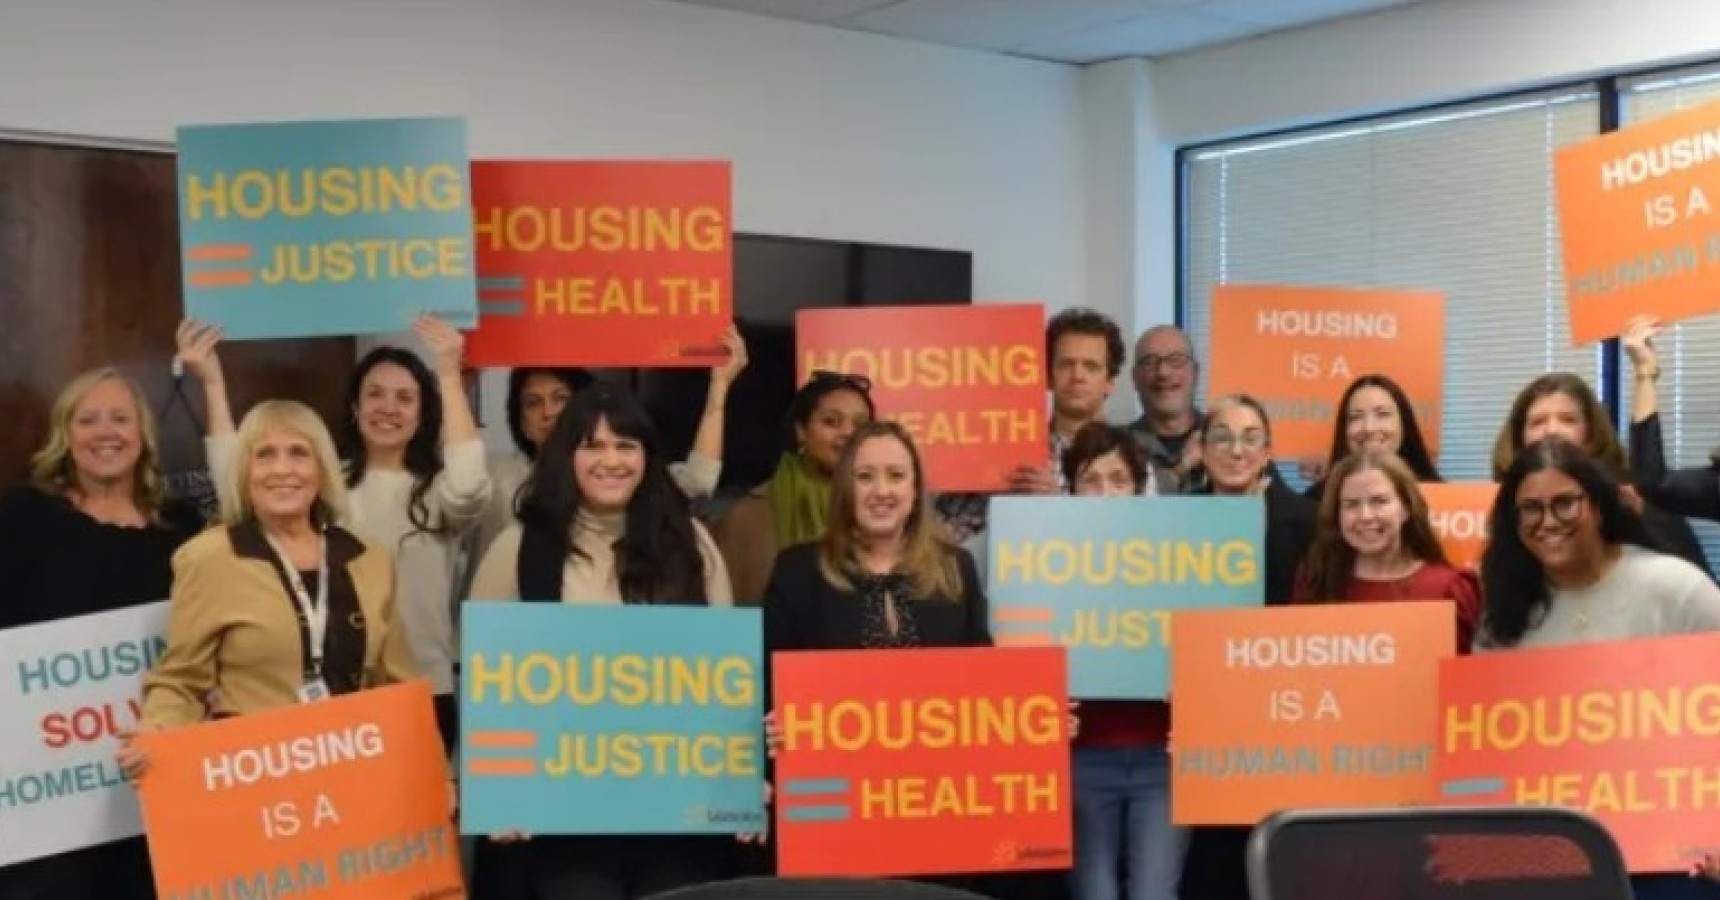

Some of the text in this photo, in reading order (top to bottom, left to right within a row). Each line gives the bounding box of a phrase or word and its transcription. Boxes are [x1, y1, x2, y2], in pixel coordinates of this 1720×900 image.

[187, 165, 461, 220] HOUSING
[1644, 186, 1711, 229] IS A
[474, 206, 724, 252] HOUSING
[261, 239, 470, 285] JUSTICE
[535, 278, 720, 315] HEALTH
[1256, 309, 1398, 339] HOUSING
[1292, 352, 1351, 379] IS A
[885, 408, 1037, 445] EALTH
[996, 539, 1258, 586] HOUSING
[1225, 633, 1396, 668] HOUSING
[470, 653, 756, 706] HOUSING
[783, 696, 1061, 753] HOUSING
[1269, 690, 1341, 721] IS A
[1444, 684, 1720, 753] HOUSING
[203, 723, 385, 790] HOUSING
[544, 733, 756, 778] JUSTICE
[1179, 744, 1321, 780] HUMAN
[262, 794, 340, 840] IS A
[861, 773, 1059, 820] HEALTH
[337, 825, 450, 882] RIGHT
